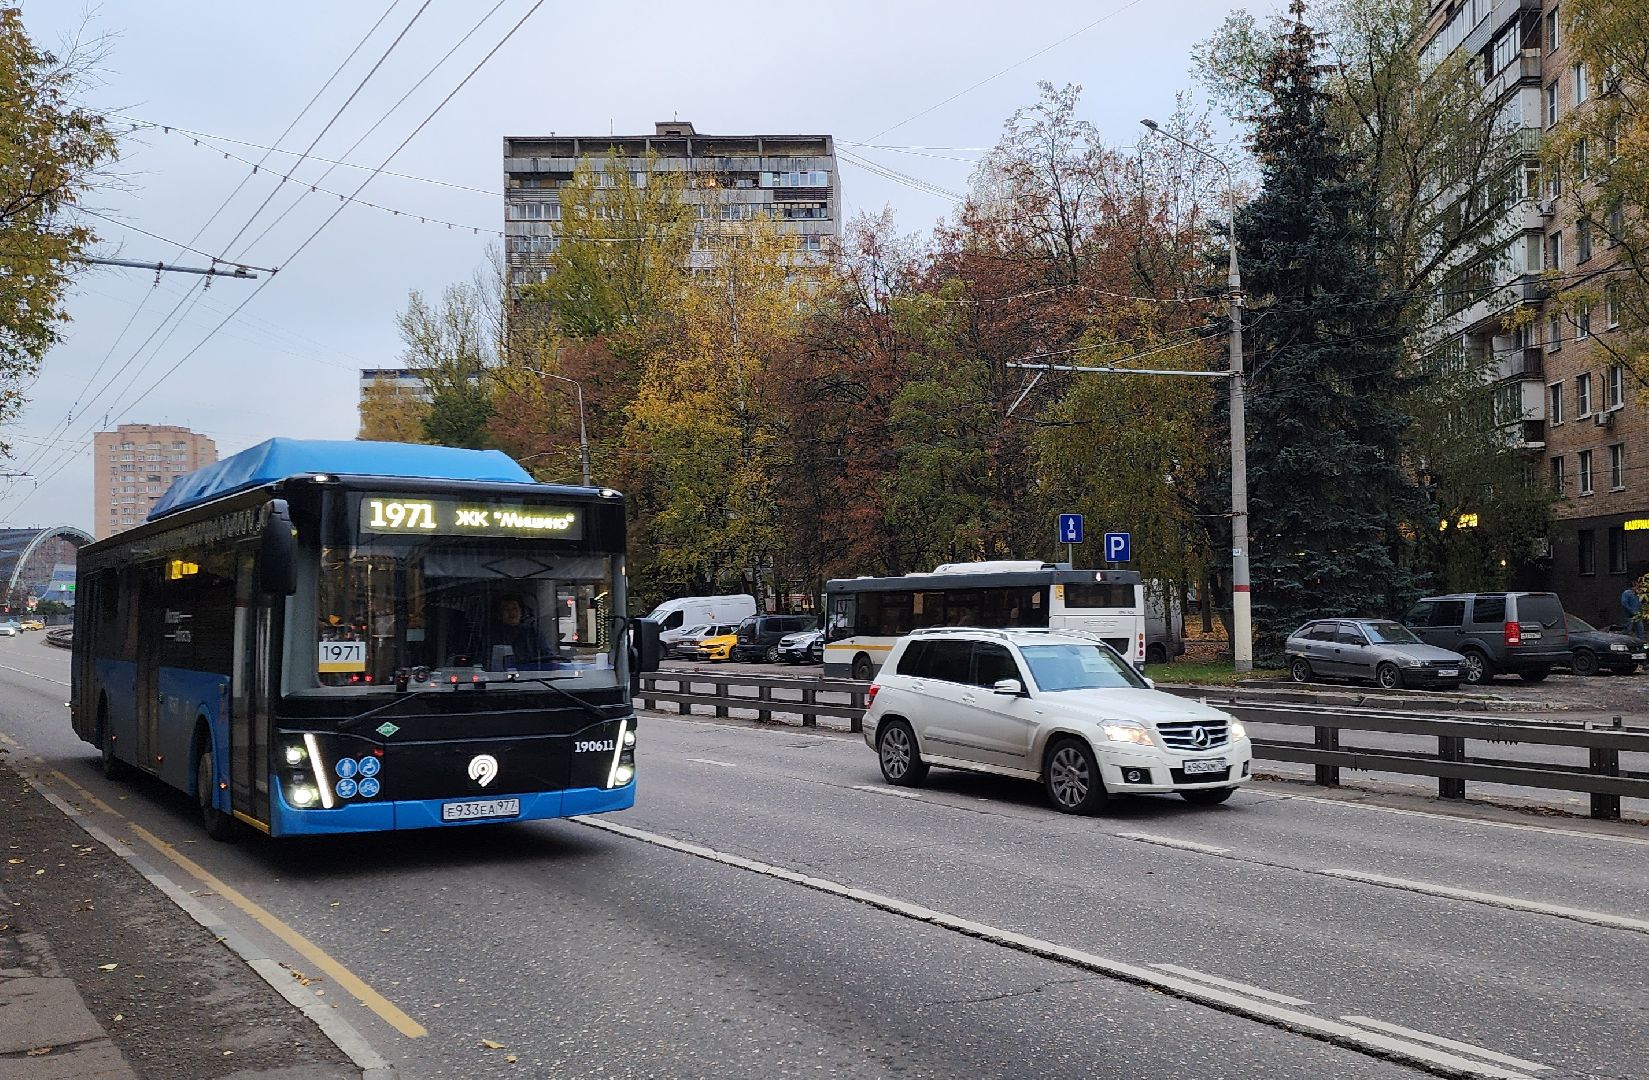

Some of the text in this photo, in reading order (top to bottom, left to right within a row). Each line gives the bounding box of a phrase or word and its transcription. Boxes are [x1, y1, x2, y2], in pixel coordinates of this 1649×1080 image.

[370, 501, 437, 529] 1971
[455, 510, 489, 527] ЖК
[1110, 536, 1125, 559] P
[323, 645, 360, 661] 1971
[574, 739, 614, 753] 190611
